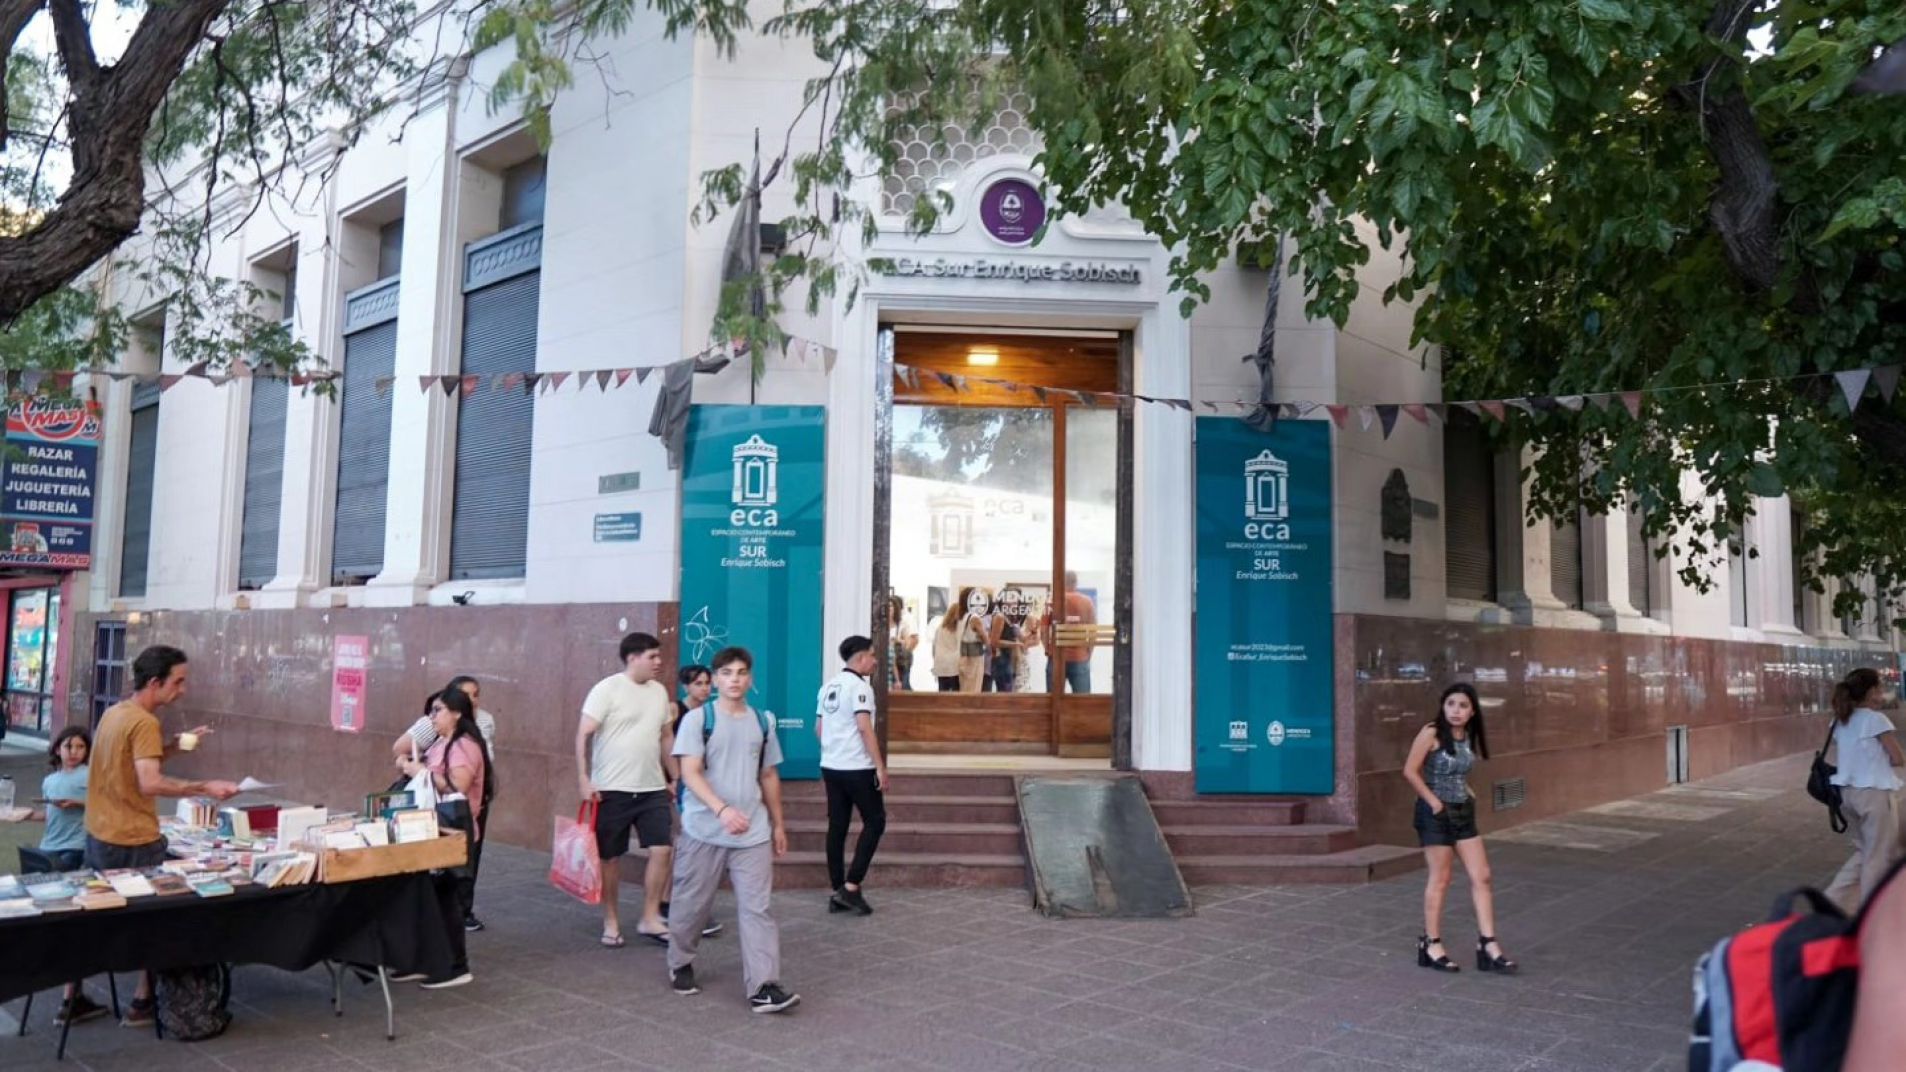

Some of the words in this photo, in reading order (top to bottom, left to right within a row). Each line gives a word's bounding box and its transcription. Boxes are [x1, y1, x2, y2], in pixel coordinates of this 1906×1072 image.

[883, 257, 924, 277] CA
[935, 258, 967, 277] Sur
[975, 259, 1053, 284] Enrique
[1061, 261, 1141, 284] Sobisch
[27, 446, 74, 462] BAZAR
[11, 463, 87, 479] REGALERÍA
[5, 480, 91, 497] JUGUETERÍA
[16, 499, 78, 514] LIBRERÍA
[730, 508, 778, 527] eca
[1244, 522, 1290, 540] eca
[739, 545, 767, 558] SUR
[721, 557, 753, 568] Enrique
[754, 558, 786, 568] Sobisch
[1253, 558, 1281, 571] SUR
[1236, 570, 1267, 581] Enrique
[1268, 571, 1299, 580] Sobisch
